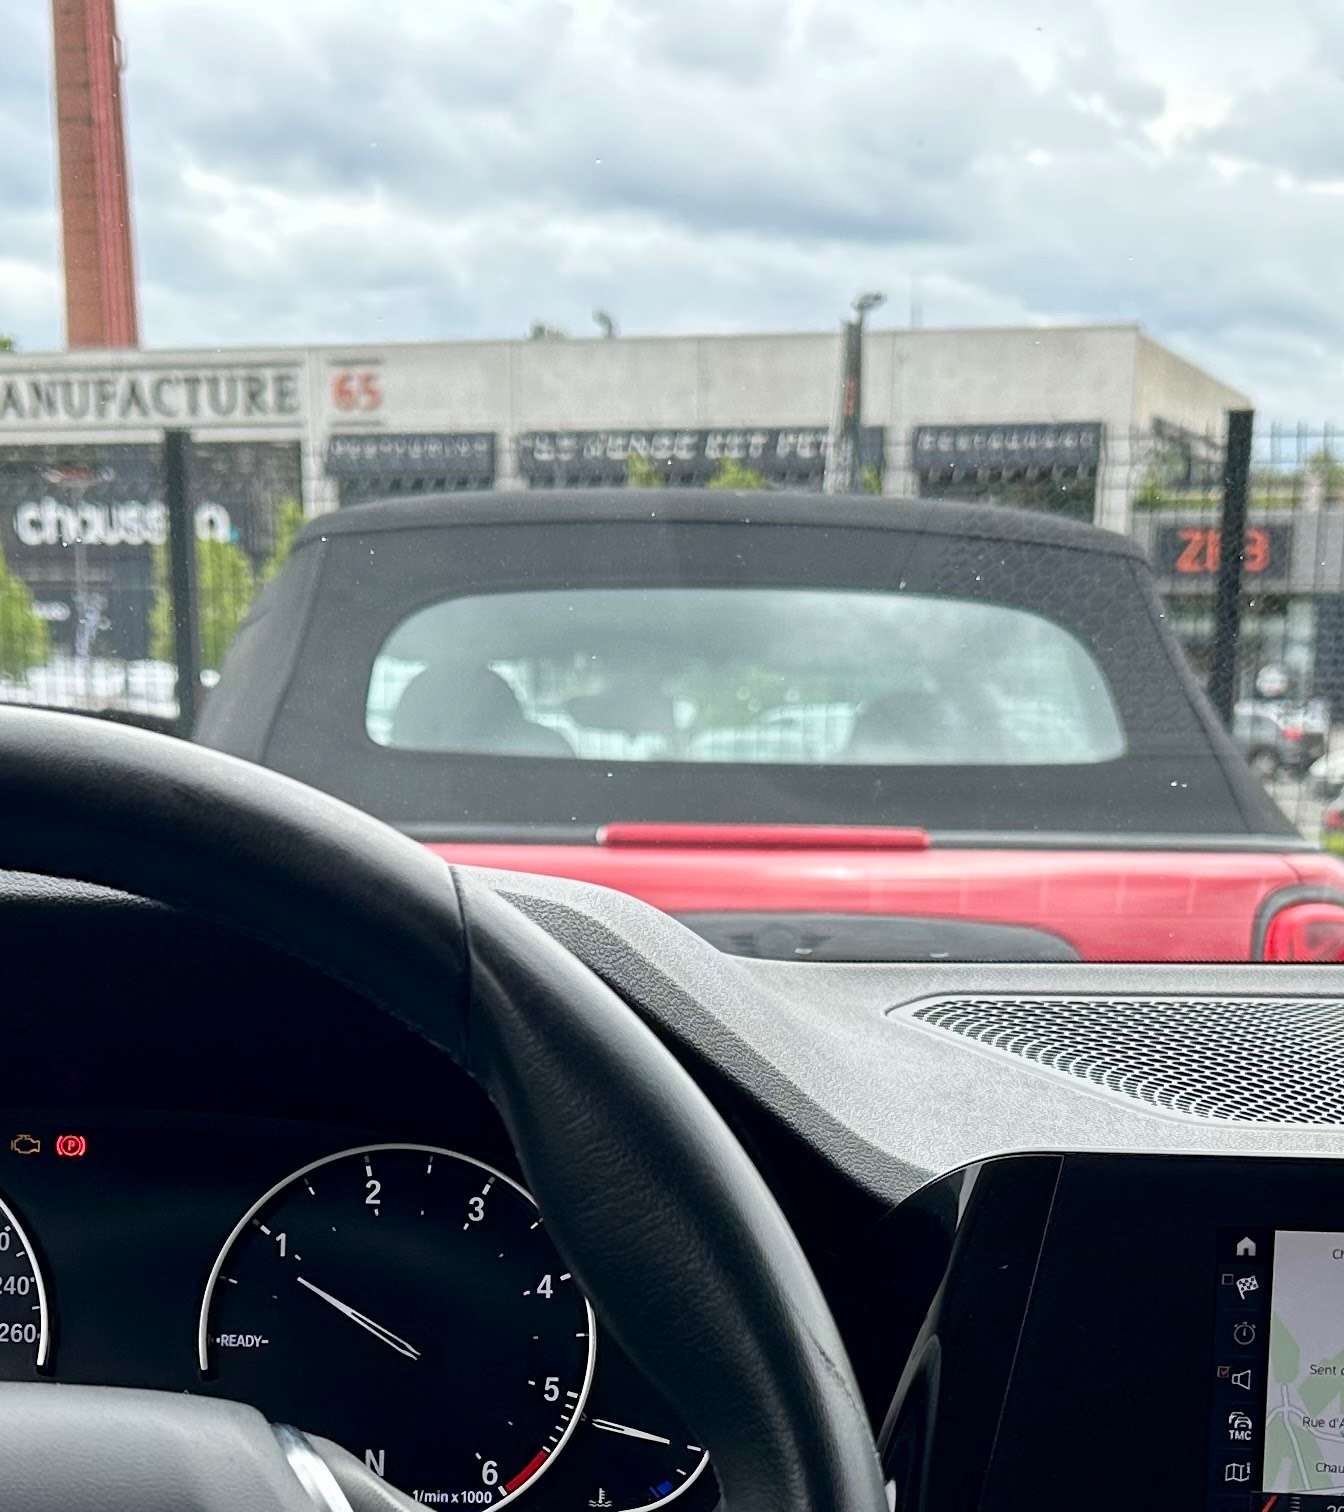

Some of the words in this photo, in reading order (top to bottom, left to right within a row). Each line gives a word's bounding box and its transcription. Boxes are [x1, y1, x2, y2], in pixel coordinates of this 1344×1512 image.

[331, 373, 384, 413] 65
[15, 497, 231, 546] chaussa
[365, 1180, 381, 1205] 2
[468, 1196, 485, 1222] 3
[275, 1234, 288, 1257] 1
[536, 1273, 554, 1298] 4
[220, 1334, 262, 1348] READY
[1309, 1364, 1336, 1376] Sent
[544, 1376, 560, 1402] 5
[1302, 1416, 1326, 1428] Rue
[1229, 1430, 1252, 1441] TMC
[364, 1450, 386, 1476] N
[481, 1460, 498, 1486] 6
[412, 1489, 449, 1503] 1/min
[450, 1493, 459, 1504] x
[460, 1490, 493, 1504] 1000
